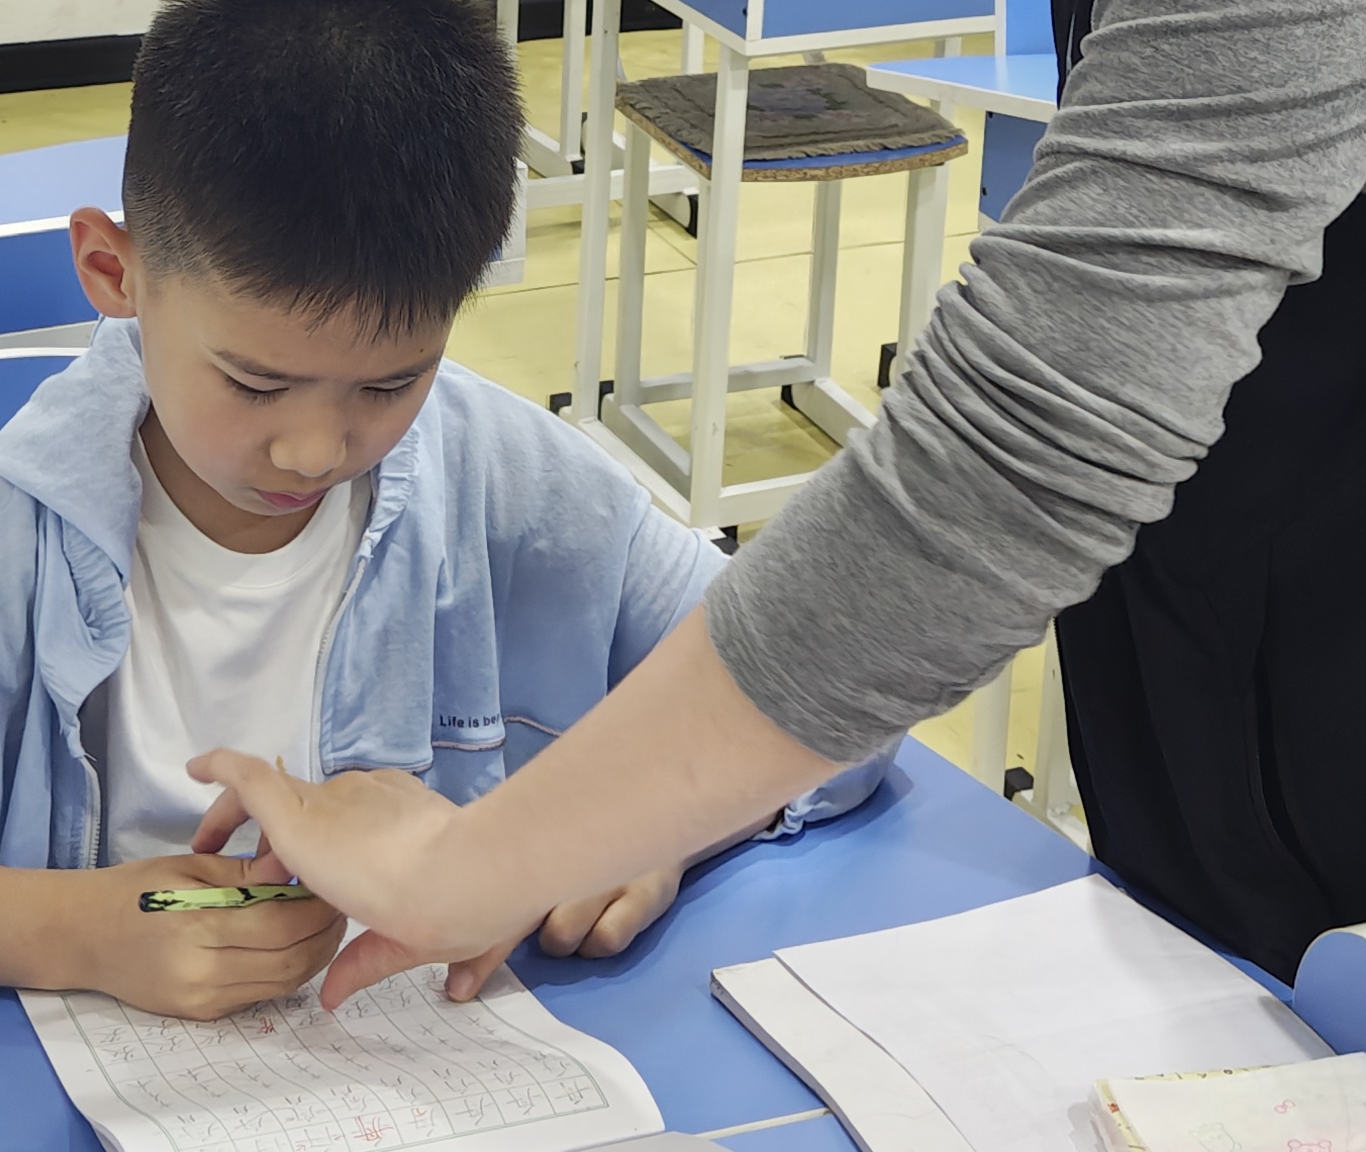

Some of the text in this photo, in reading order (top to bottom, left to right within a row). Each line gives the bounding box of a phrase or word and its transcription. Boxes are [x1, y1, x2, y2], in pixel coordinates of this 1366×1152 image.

[439, 712, 500, 728] Life is be
